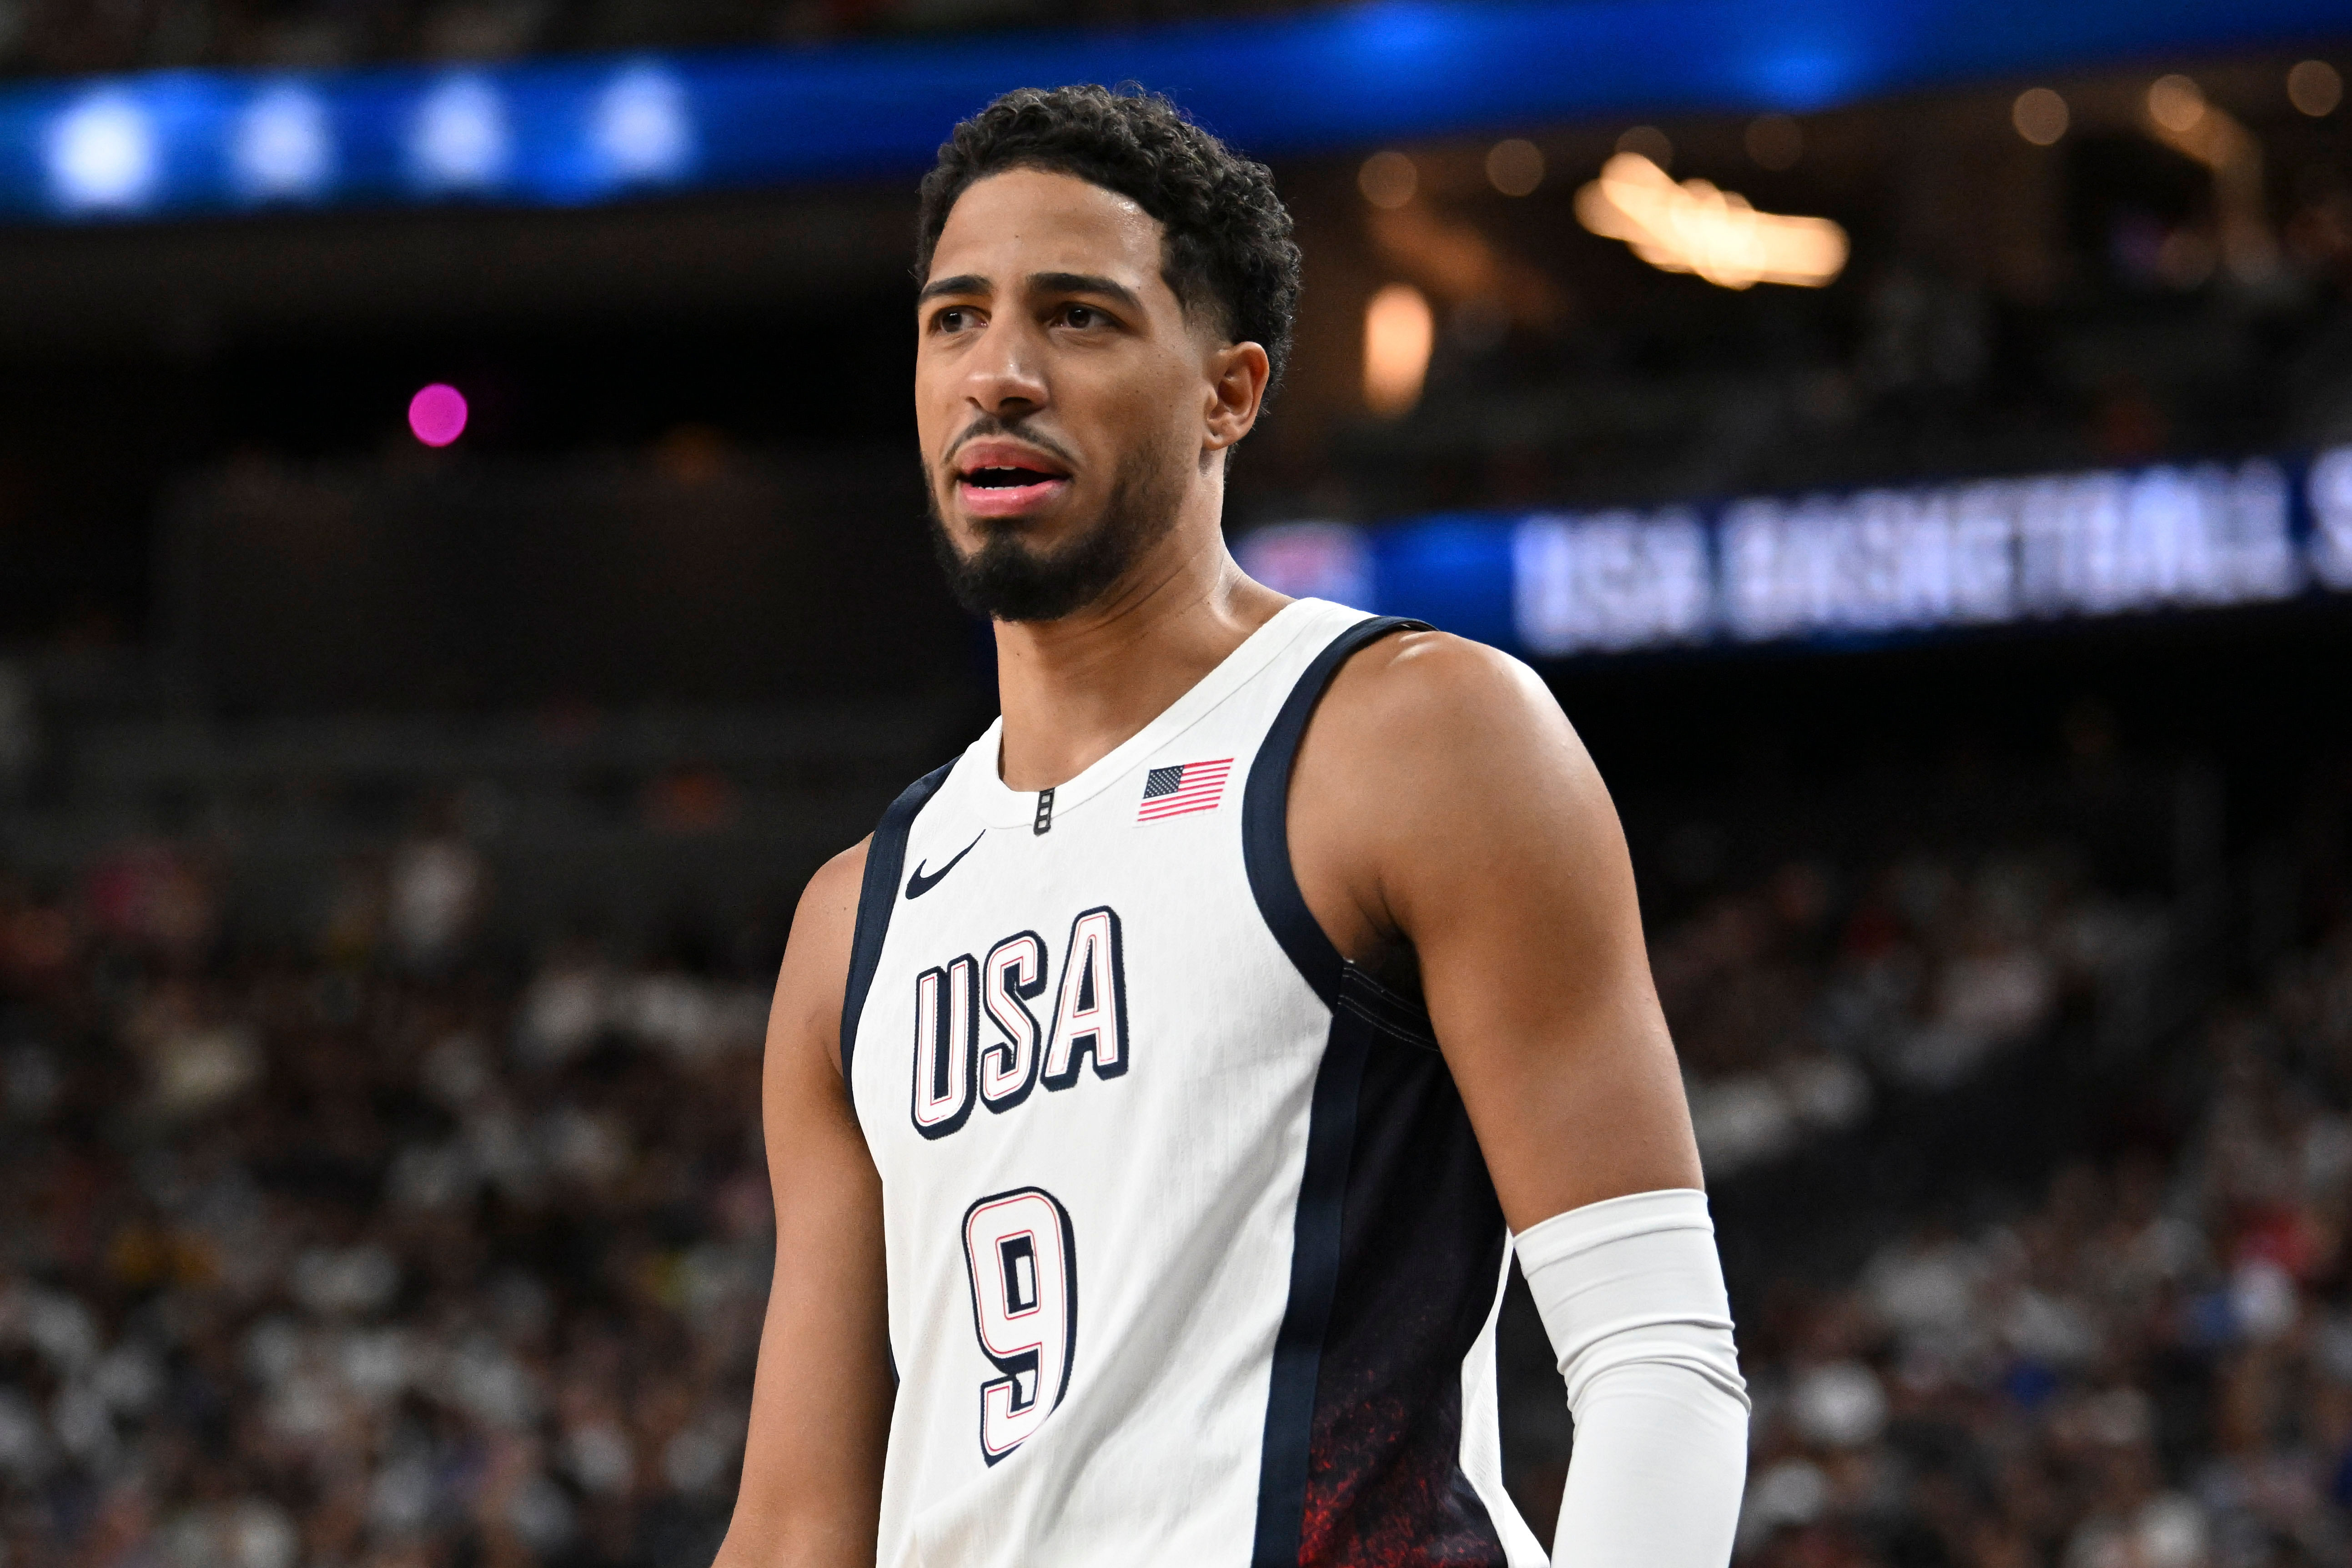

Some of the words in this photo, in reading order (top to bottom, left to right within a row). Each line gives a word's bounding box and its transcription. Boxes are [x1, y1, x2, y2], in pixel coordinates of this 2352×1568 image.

[1517, 506, 1709, 651] USA
[1724, 464, 2297, 640] BASKETBALL
[911, 905, 1129, 1140] USA
[961, 1186, 1078, 1468] 9
